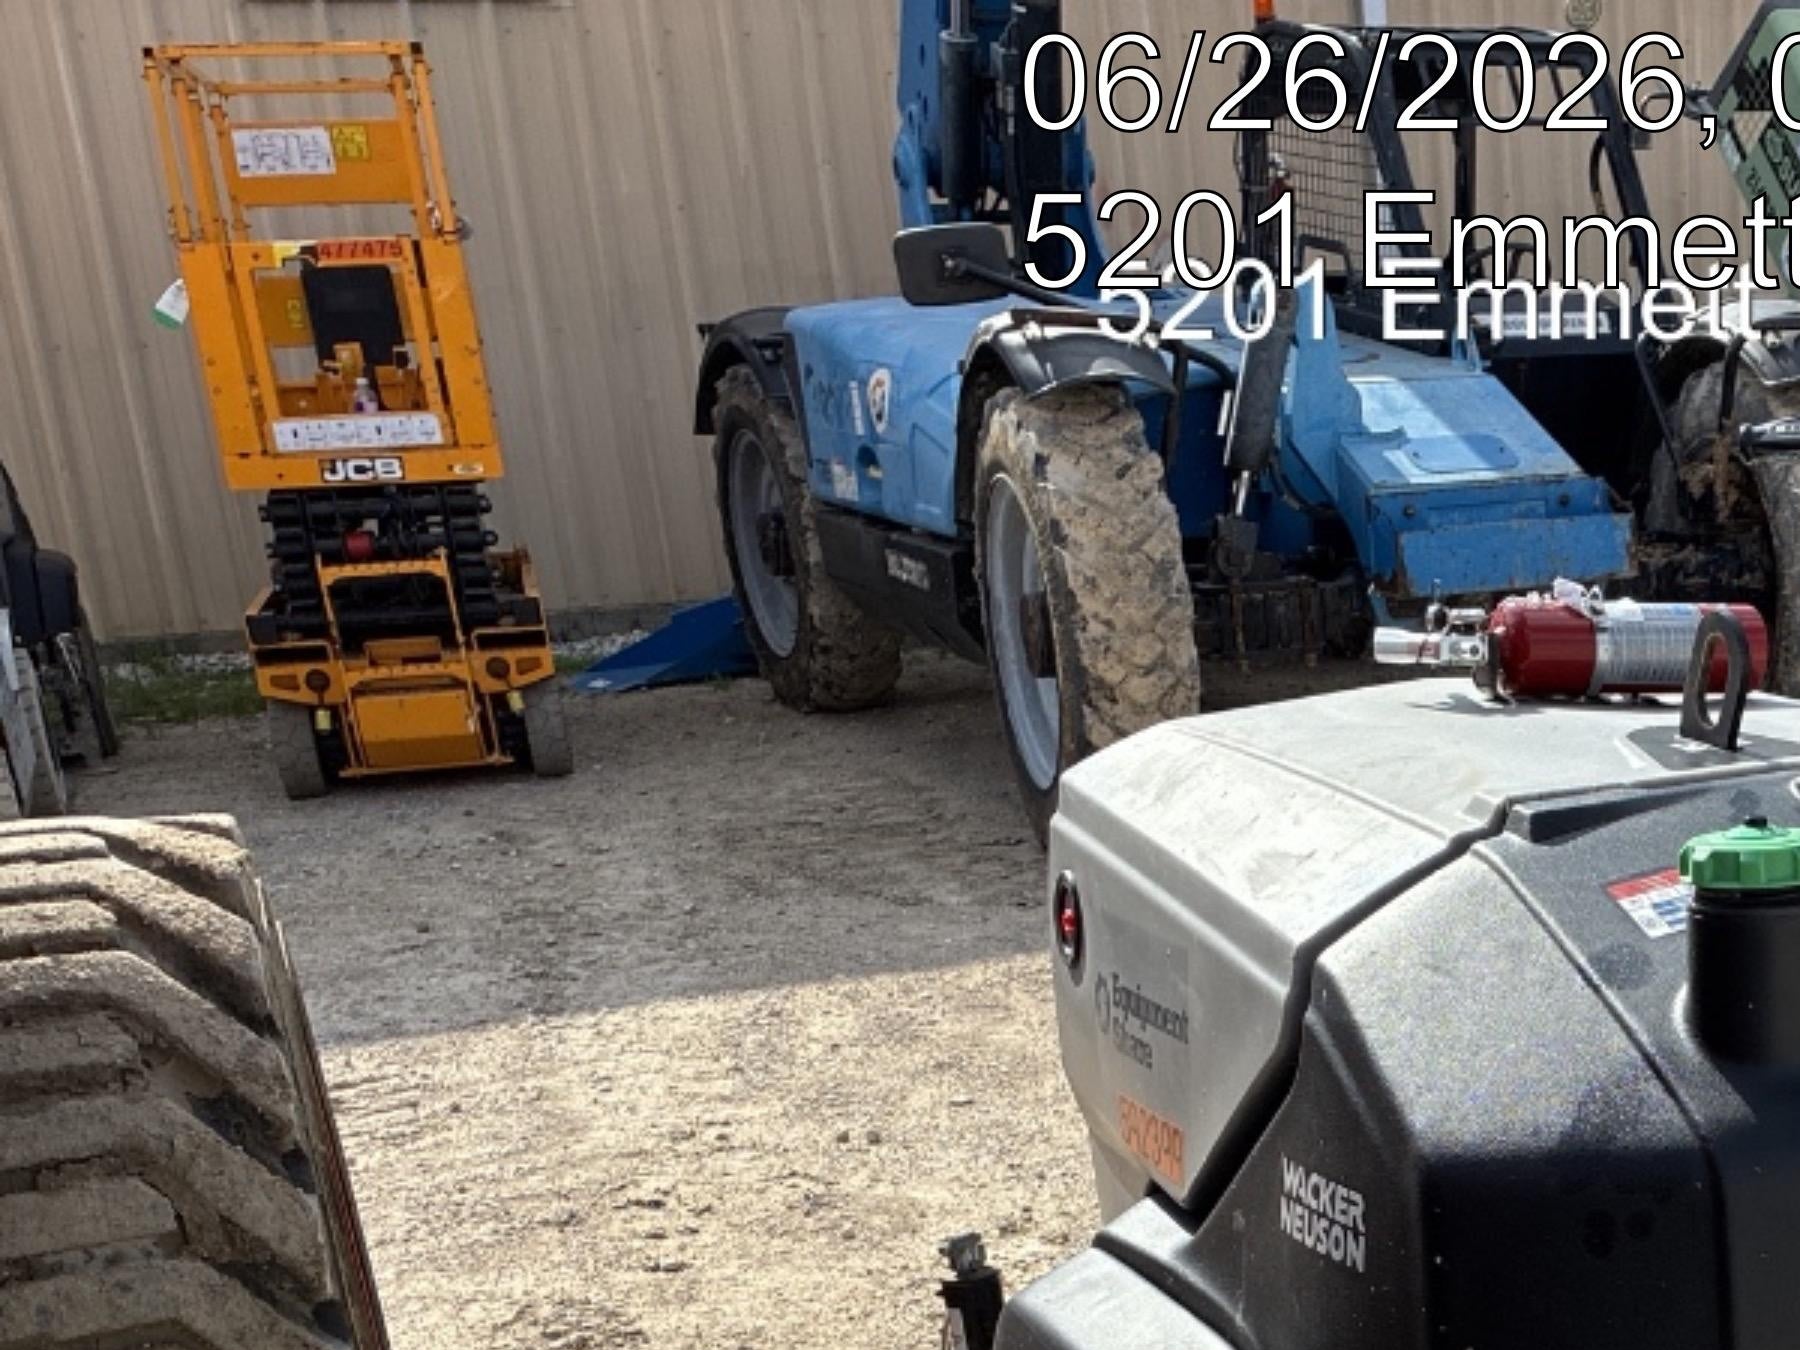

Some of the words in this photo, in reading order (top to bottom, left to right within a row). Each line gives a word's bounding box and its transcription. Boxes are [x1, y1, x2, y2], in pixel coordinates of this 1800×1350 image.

[323, 457, 403, 482] JCB
[1281, 1152, 1366, 1233] WACKER
[1279, 1195, 1367, 1273] NEUSON
